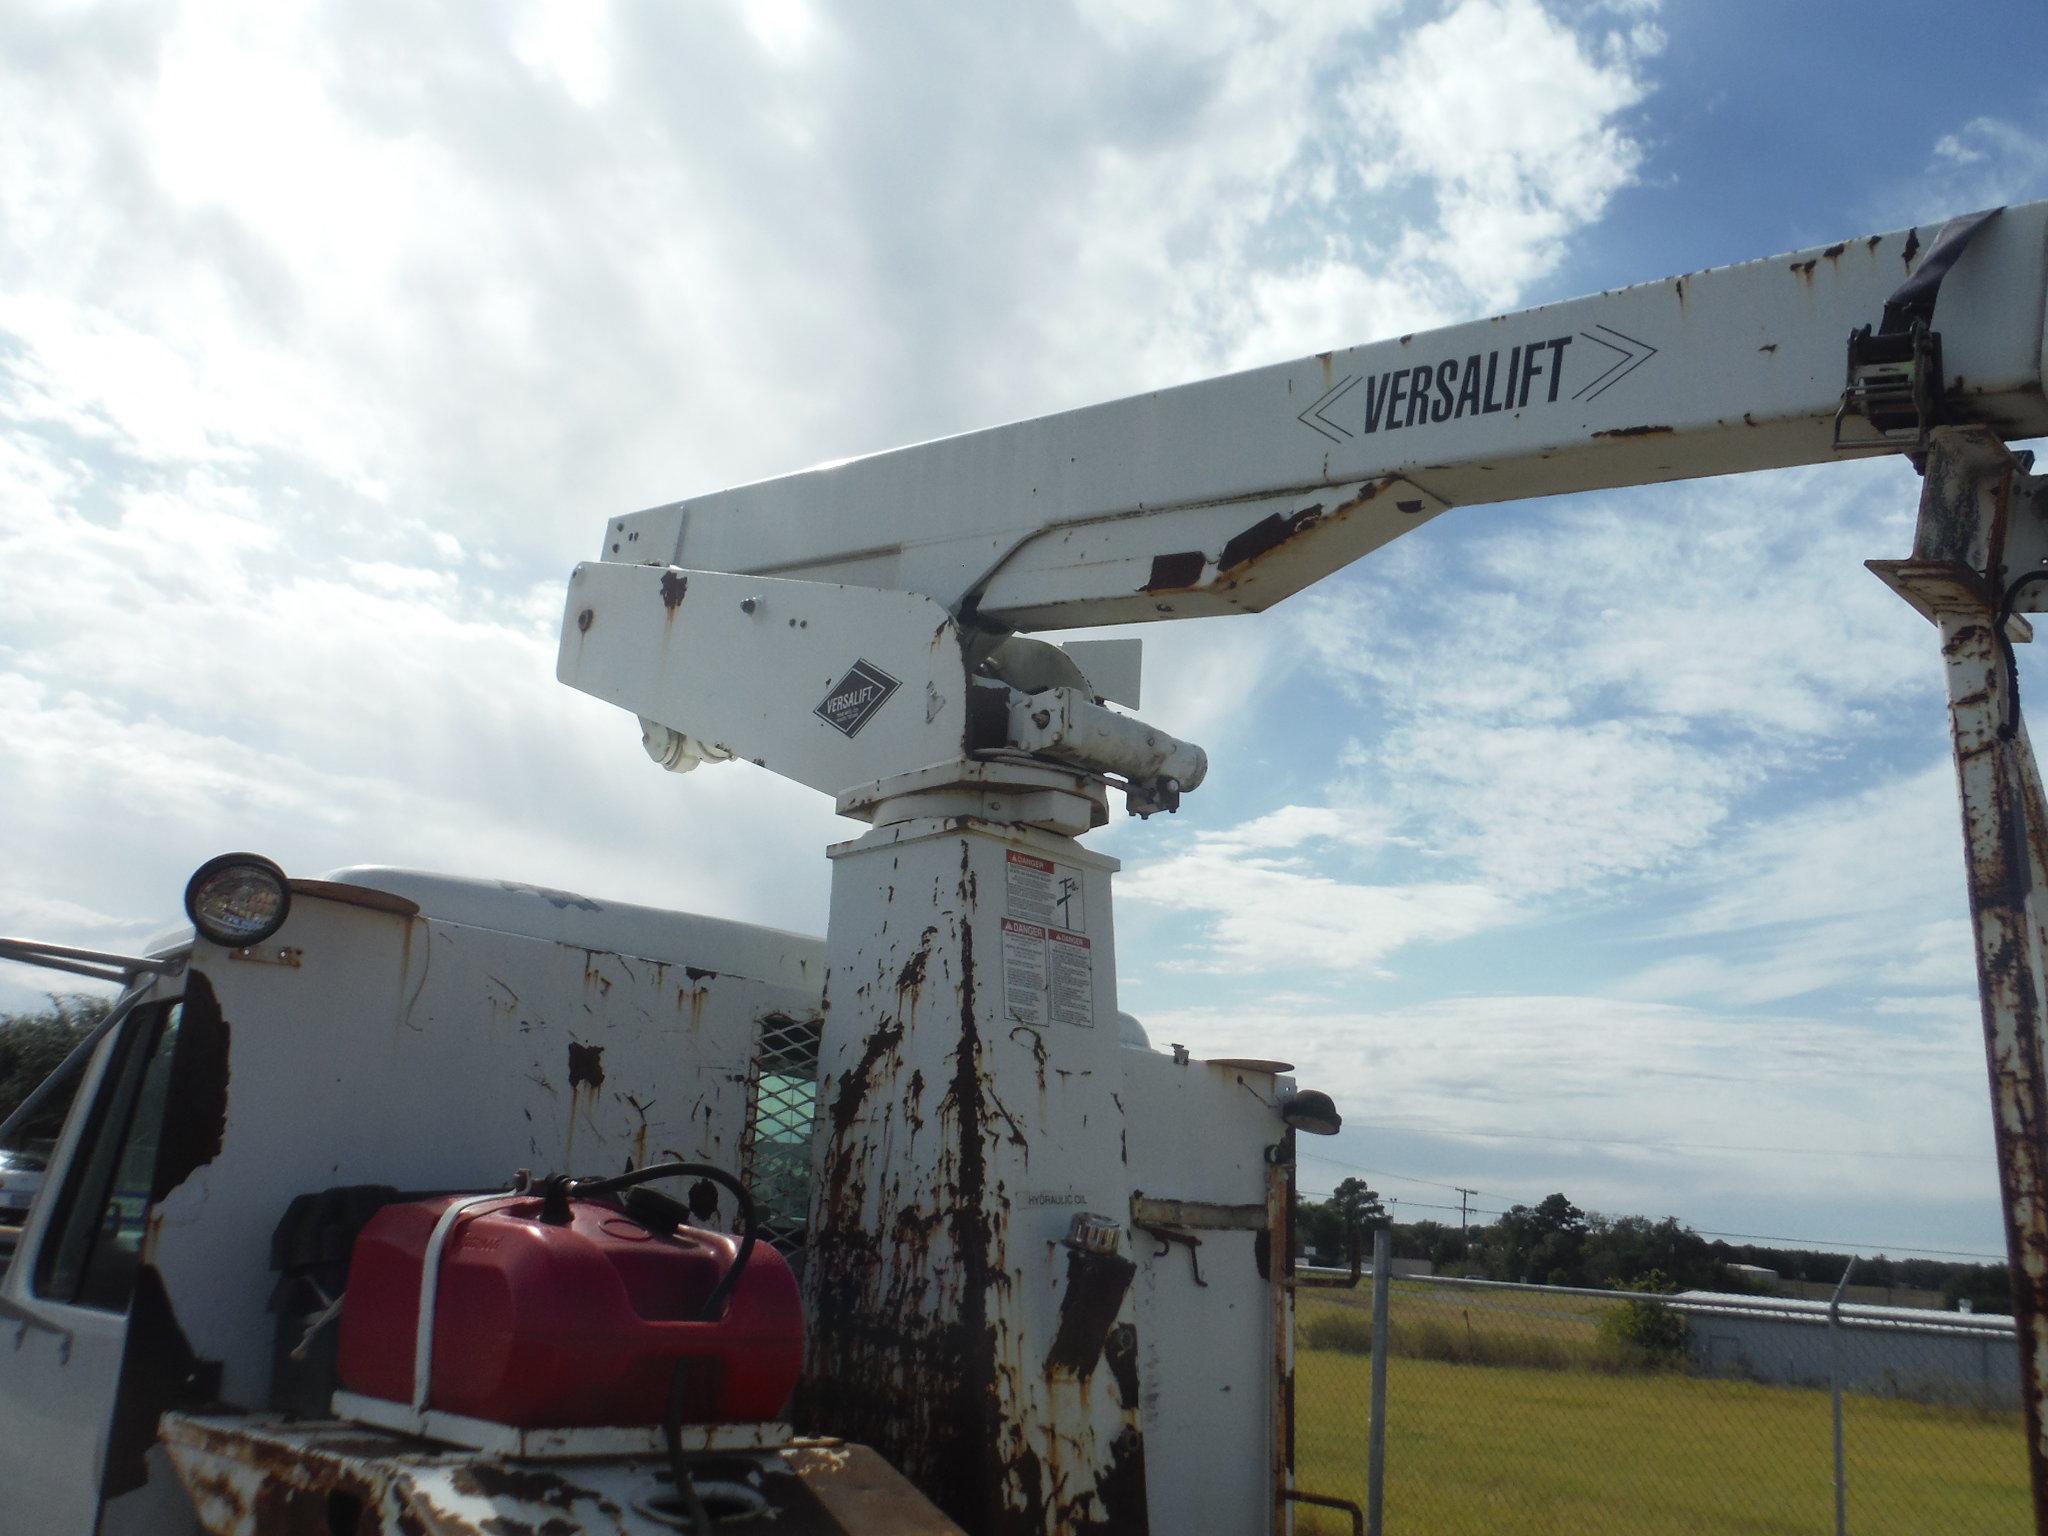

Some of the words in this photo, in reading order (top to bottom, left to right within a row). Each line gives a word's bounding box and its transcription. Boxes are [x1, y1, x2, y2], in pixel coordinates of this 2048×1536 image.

[1364, 336, 1573, 434] VERSALIFT
[827, 686, 873, 714] VERSALIFT
[1017, 857, 1044, 869] DANGER
[1013, 924, 1043, 937] DANGER
[1061, 935, 1083, 946] DANGER
[1029, 1194, 1072, 1205] HYDRAULIC
[1075, 1194, 1087, 1204] OIL
